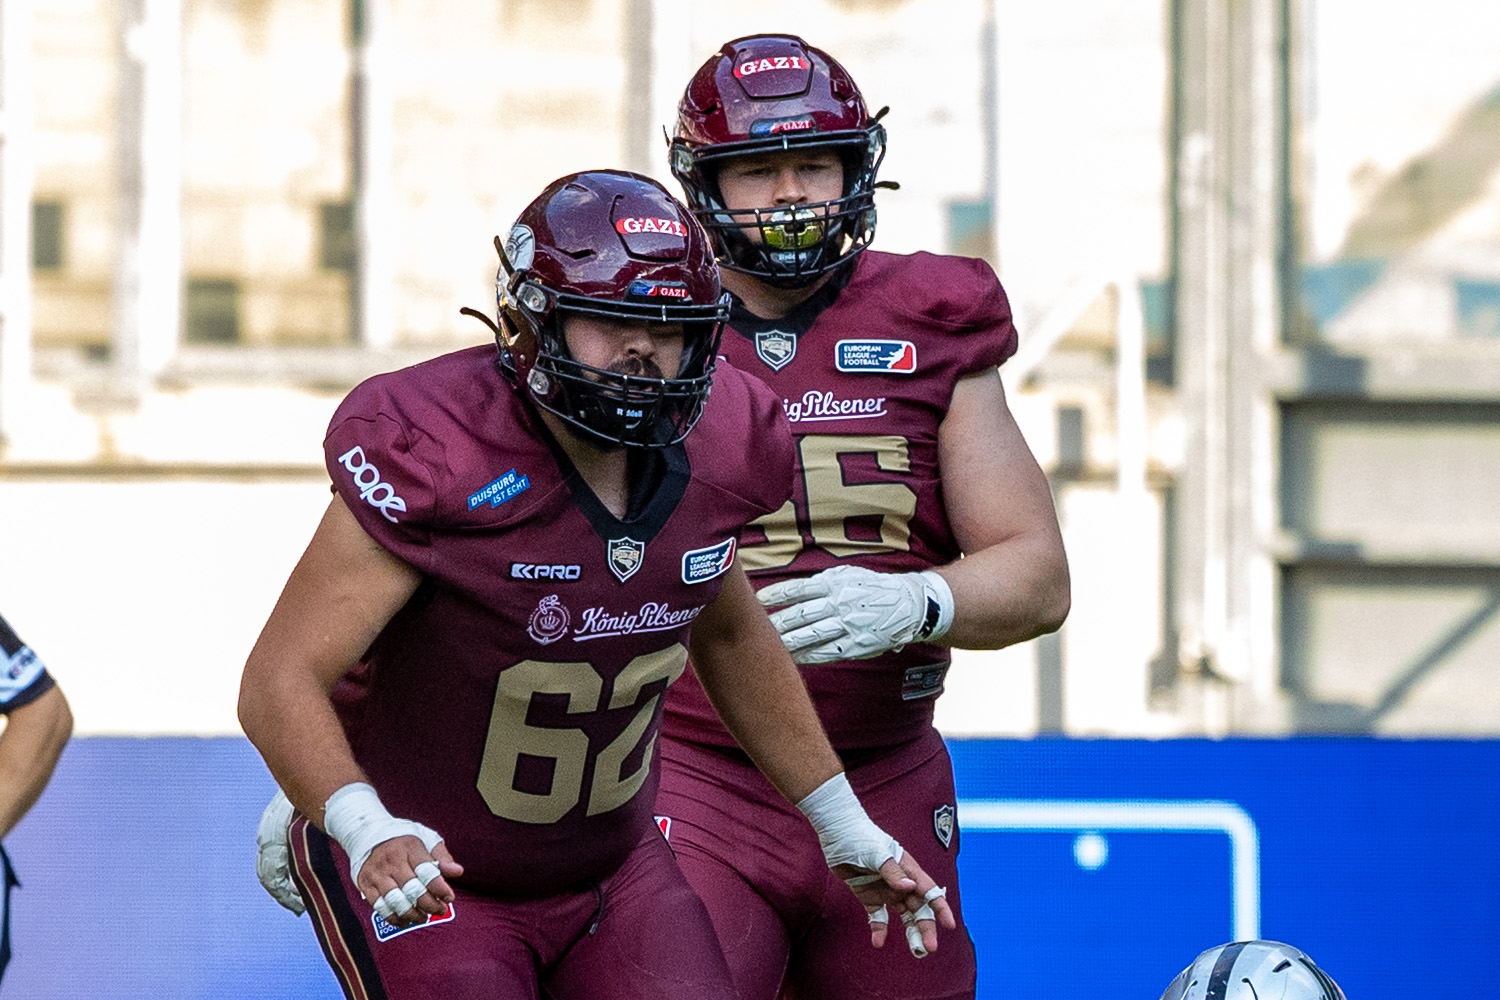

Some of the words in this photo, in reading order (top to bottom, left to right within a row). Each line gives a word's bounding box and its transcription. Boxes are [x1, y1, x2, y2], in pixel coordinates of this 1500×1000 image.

[740, 57, 802, 76] GAZI
[782, 121, 810, 131] GAZI
[623, 217, 687, 237] GAZI
[660, 287, 686, 298] GAZI
[338, 446, 407, 523] pape
[471, 473, 515, 507] DUISBURG
[493, 490, 506, 504] IST
[506, 478, 527, 496] ECHT
[476, 642, 689, 825] 62
